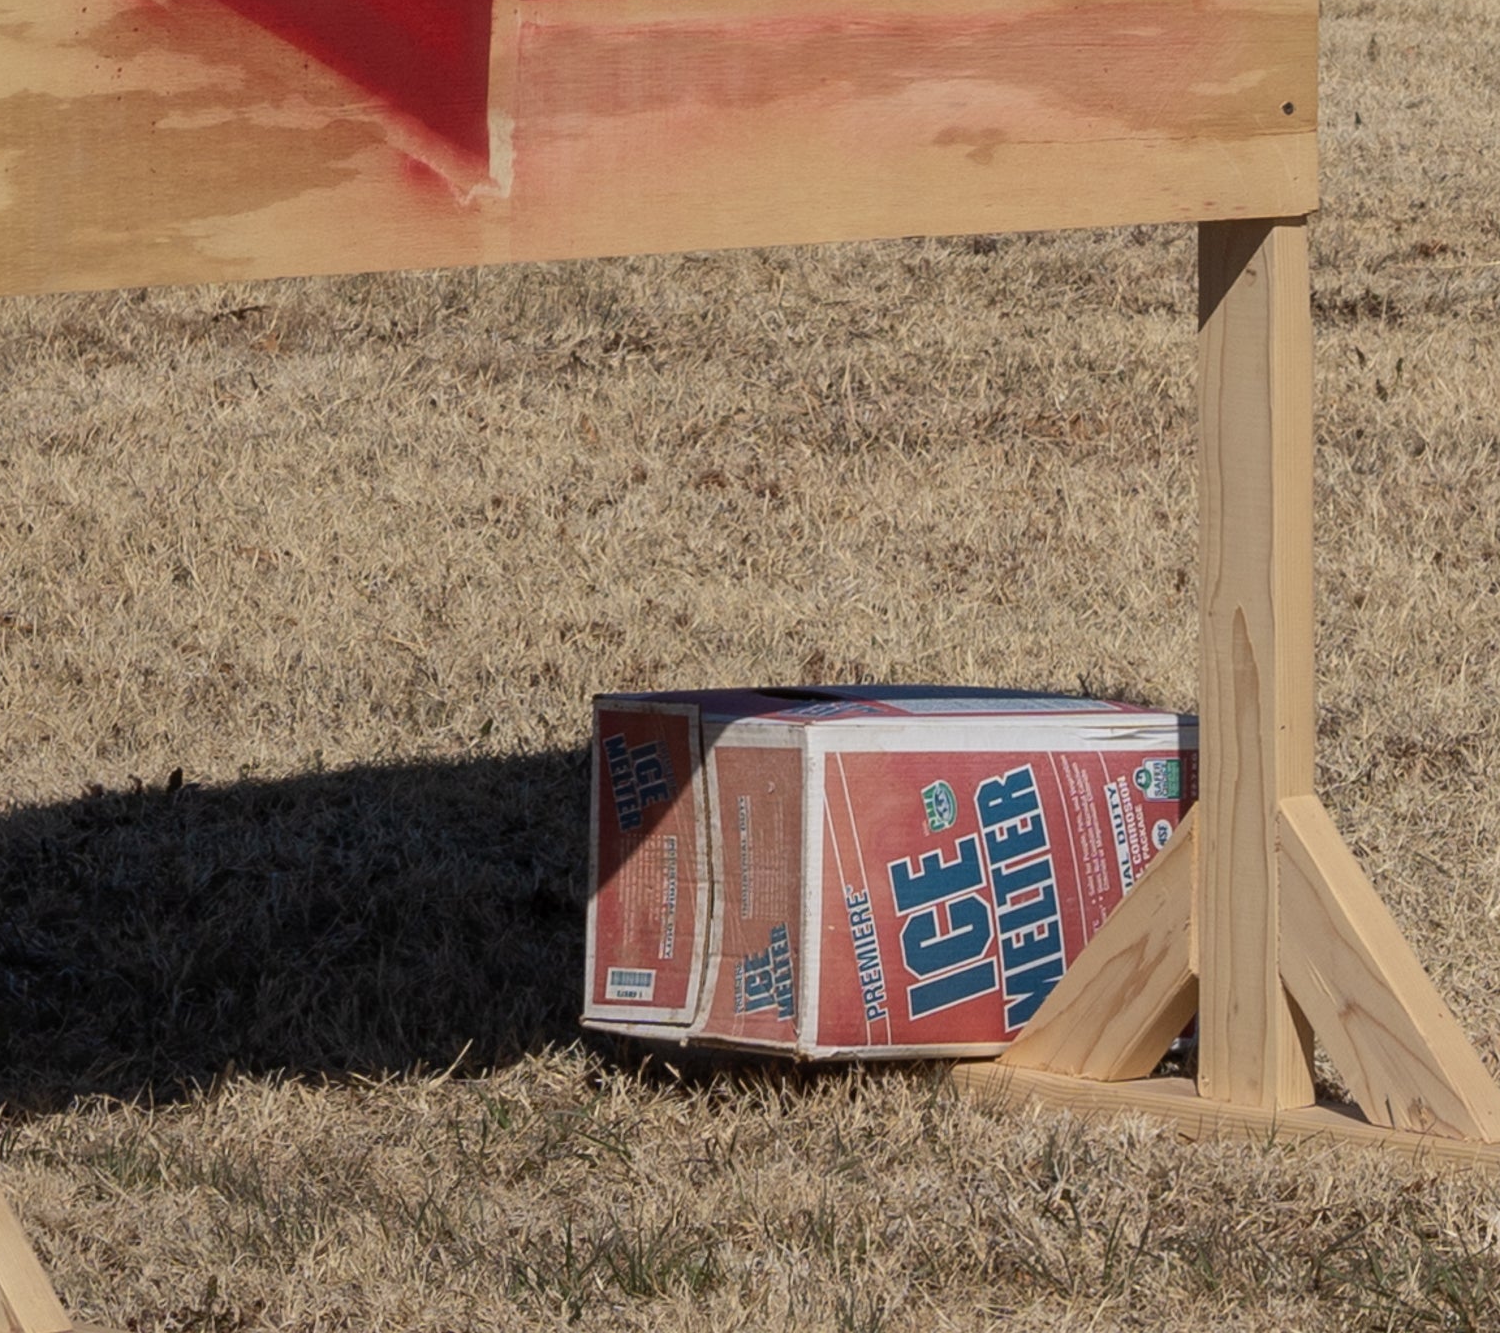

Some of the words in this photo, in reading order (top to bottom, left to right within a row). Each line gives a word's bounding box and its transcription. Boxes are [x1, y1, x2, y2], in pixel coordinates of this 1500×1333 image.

[603, 733, 643, 832] MELTER
[629, 742, 669, 807] ICE
[1107, 787, 1125, 844] DUTY
[1117, 775, 1142, 864] CORROSION
[1134, 804, 1150, 859] PACKAGE
[887, 833, 1000, 1020] ICE
[974, 763, 1067, 1031] MELTER
[744, 947, 777, 1011] ICE
[770, 922, 795, 1018] MELTER
[844, 890, 888, 1020] PREMIERE
